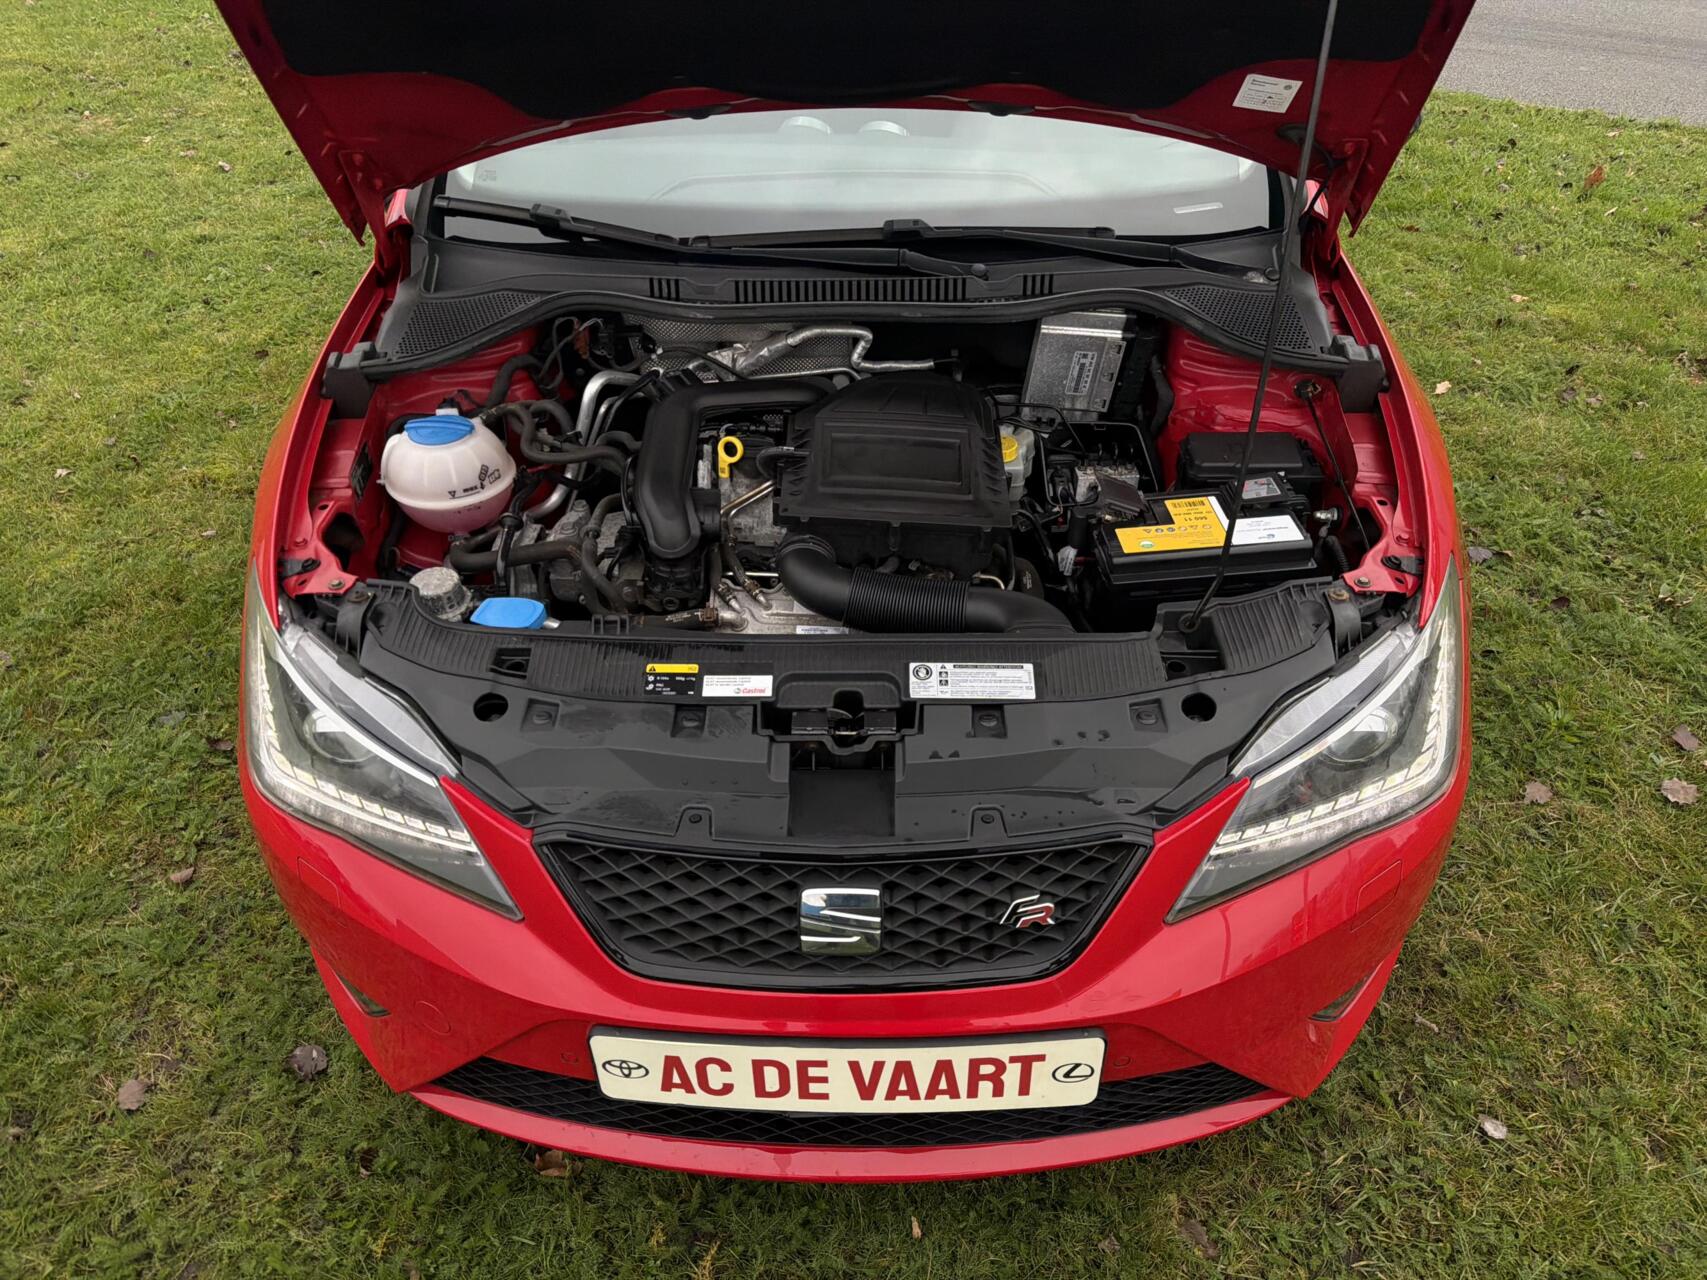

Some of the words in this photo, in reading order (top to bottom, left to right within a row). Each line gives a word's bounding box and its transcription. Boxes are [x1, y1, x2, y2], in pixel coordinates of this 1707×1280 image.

[999, 894, 1056, 929] FR
[660, 1054, 733, 1097] AC
[751, 1058, 831, 1101] DE
[846, 1053, 1047, 1102] VAART
